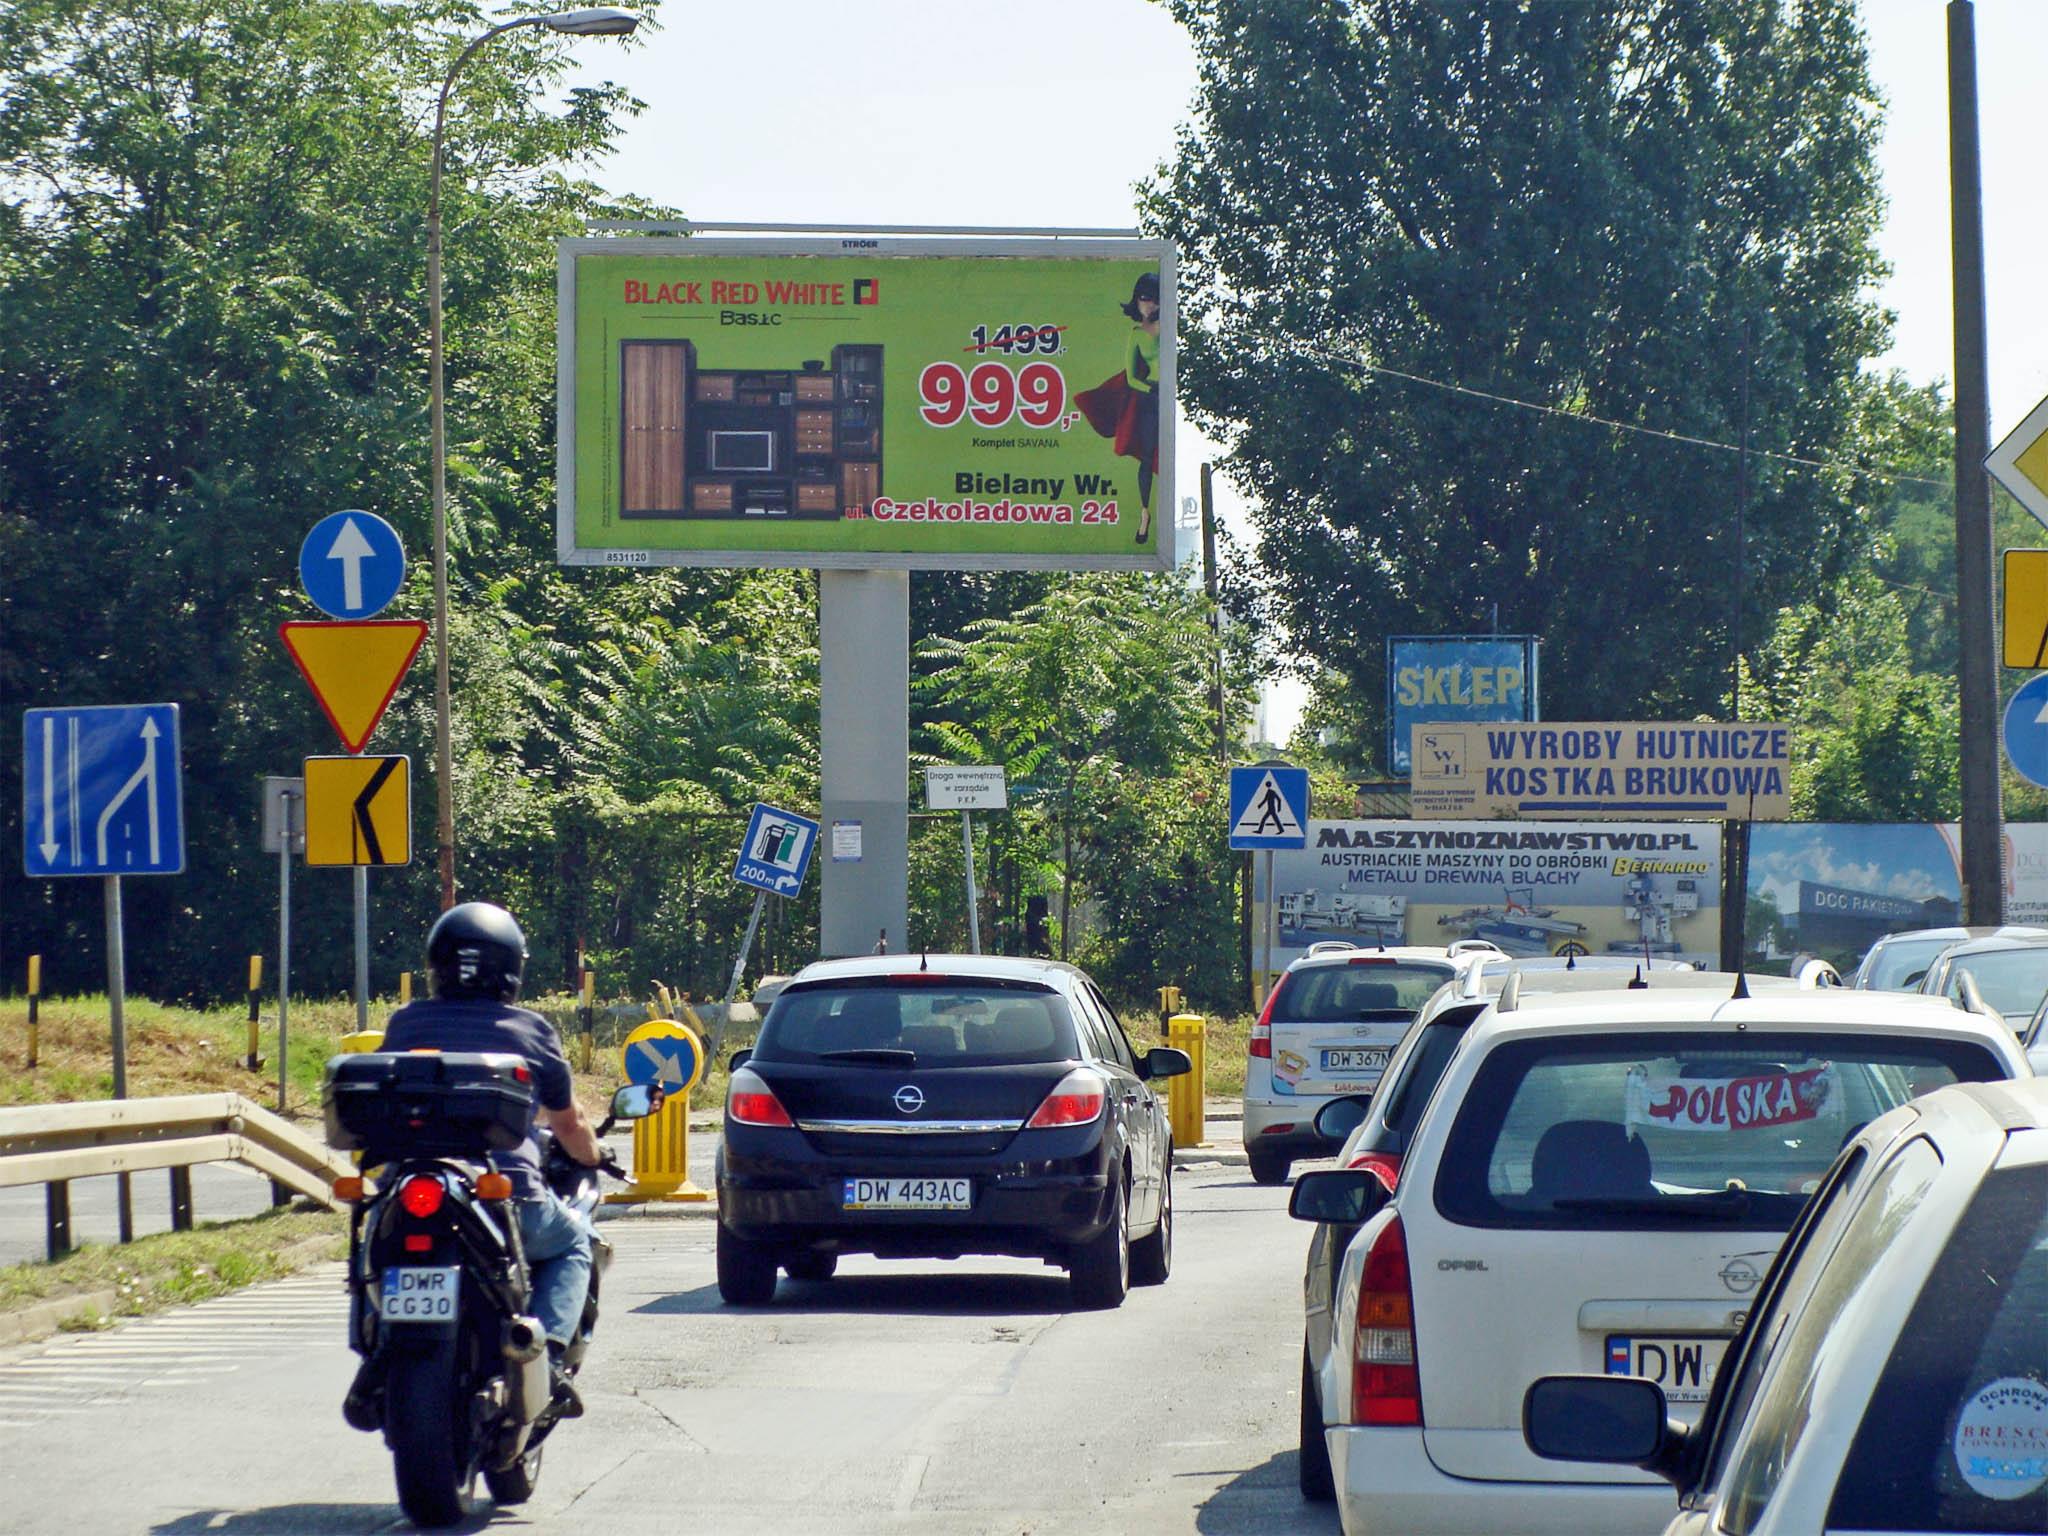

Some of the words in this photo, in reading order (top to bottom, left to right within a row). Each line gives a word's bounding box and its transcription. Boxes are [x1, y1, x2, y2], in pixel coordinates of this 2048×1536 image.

[624, 280, 703, 305] BLACK
[711, 280, 759, 305] RED
[764, 281, 845, 306] WHITE
[720, 310, 782, 327] Basic
[972, 437, 1015, 449] Komplet
[1017, 438, 1059, 449] SAVANA
[955, 472, 1064, 500] Bielany
[1074, 473, 1118, 496] Wr.
[845, 503, 868, 520] ul.
[872, 496, 1073, 523] Czekoladowa
[1081, 500, 1119, 525] 24
[606, 552, 647, 562] 8531120
[1399, 665, 1521, 707] SKLEP
[1488, 729, 1622, 760] WYROBY
[1636, 729, 1788, 760] HUTNICZE
[1485, 766, 1615, 796] KOSTKA
[1625, 766, 1783, 796] BRUKOWA
[1316, 828, 1699, 851] MASZYNOZNAWSTWO.PL
[1321, 853, 1422, 867] AUSTRIACKIE
[1426, 854, 1505, 868] MASZYNY
[1509, 855, 1532, 868] DO
[1536, 852, 1607, 869] OBRÓBKI
[1611, 857, 1708, 877] BERNARDO
[1348, 869, 1418, 884] METALU
[1424, 870, 1505, 885] DREWNA
[1511, 871, 1580, 885] BLACHY
[1815, 890, 1848, 909] DCC
[1330, 1052, 1352, 1067] DW
[1648, 1078, 1797, 1124] POLSKA
[858, 1181, 890, 1202] DW
[898, 1181, 966, 1202] 443AC
[401, 1273, 446, 1291] DWR
[387, 1297, 450, 1315] CG30
[1638, 1343, 1702, 1387] DW
